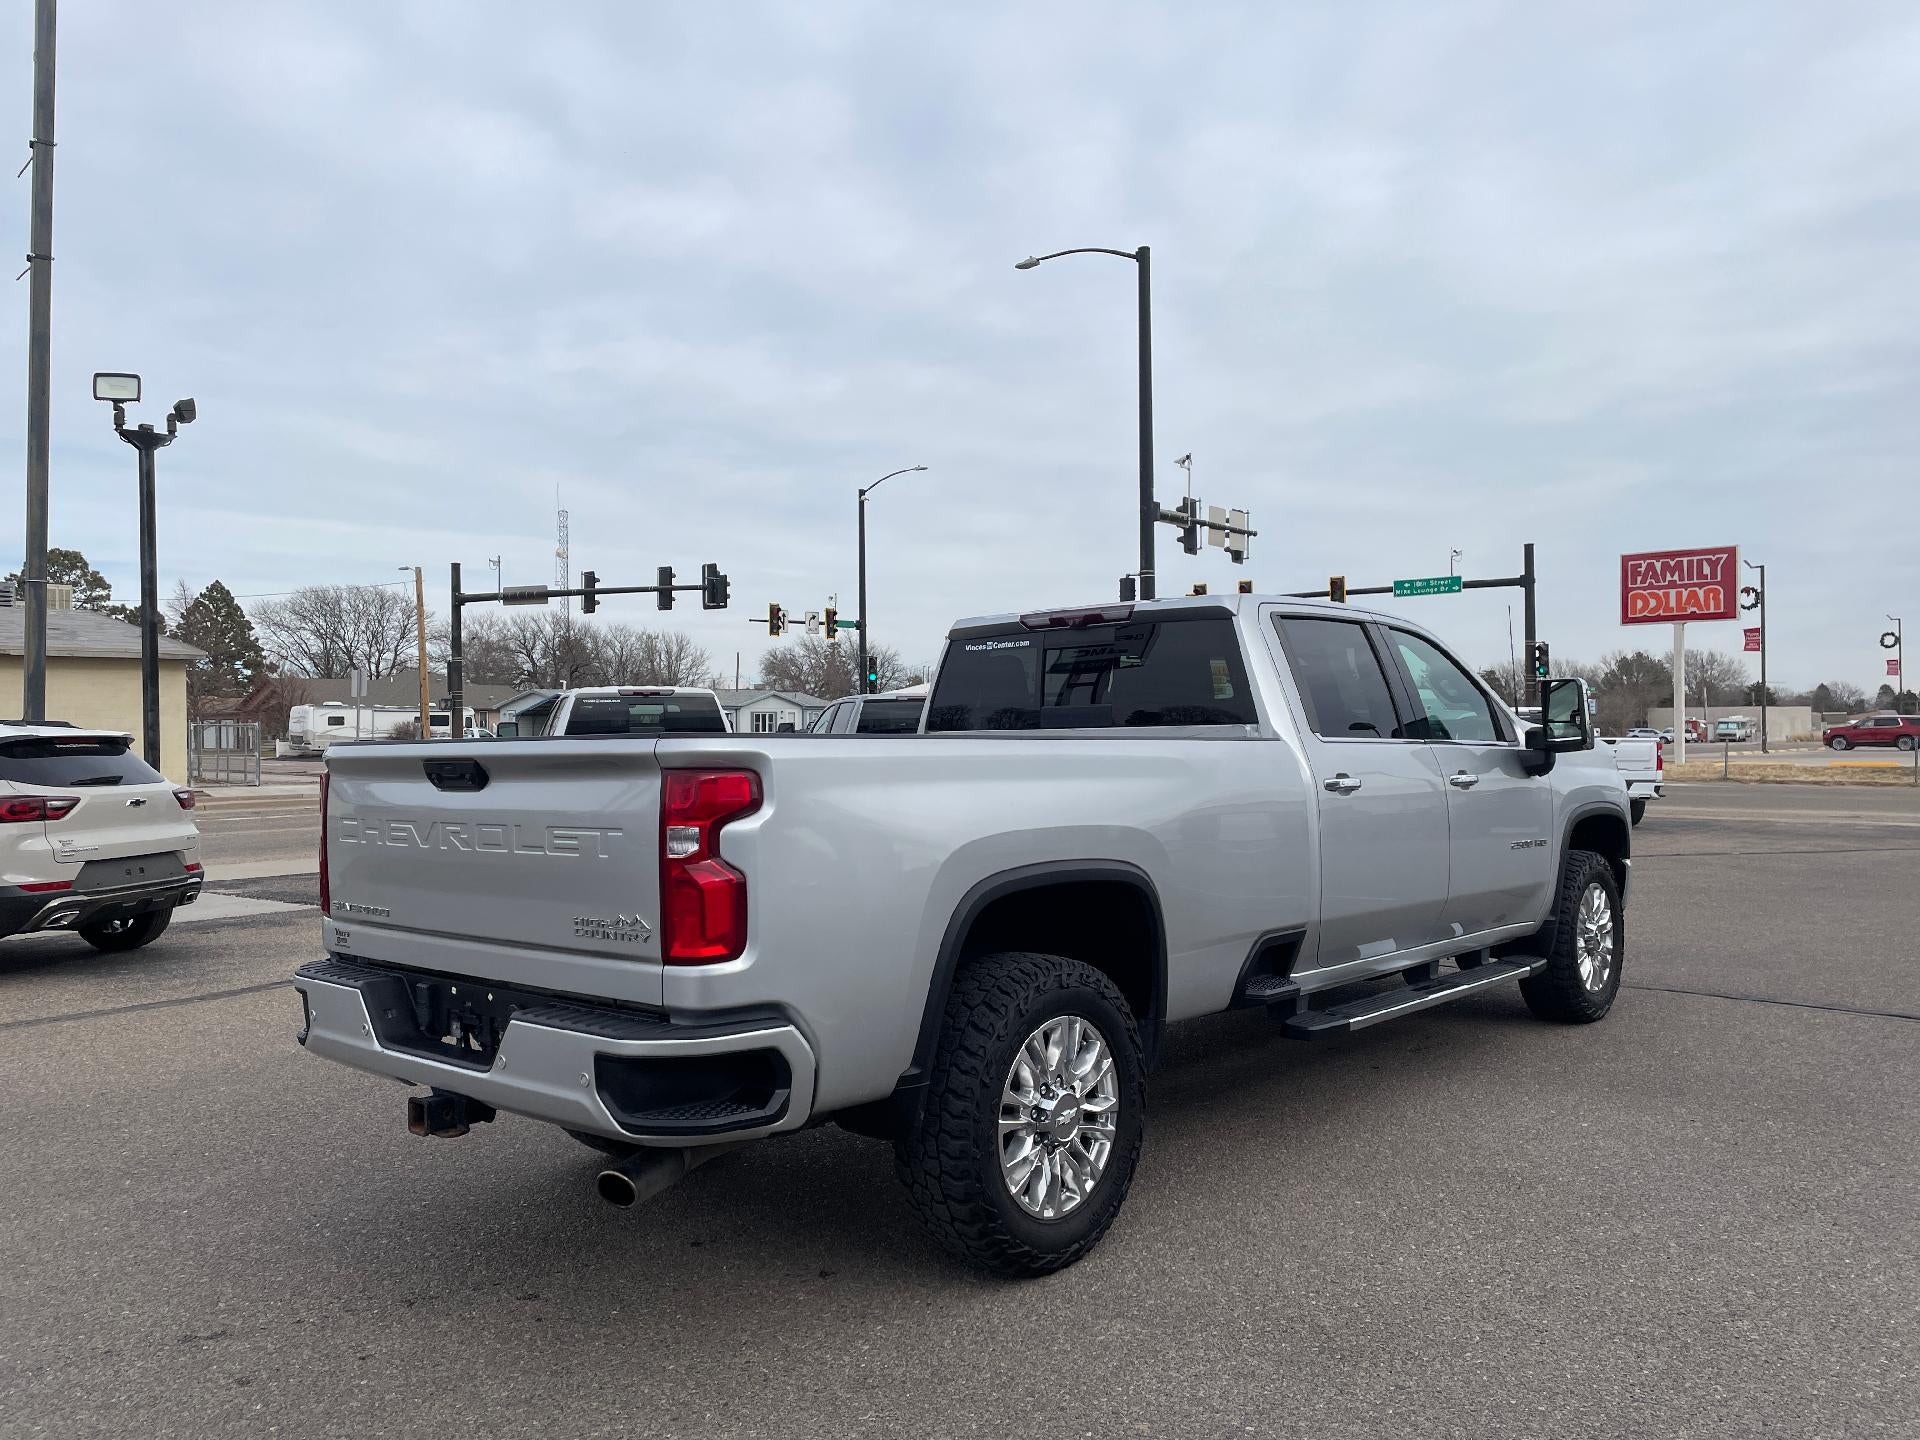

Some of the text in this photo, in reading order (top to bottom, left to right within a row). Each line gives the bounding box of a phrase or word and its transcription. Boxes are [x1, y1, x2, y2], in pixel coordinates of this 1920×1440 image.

[1629, 554, 1728, 587] FAMILY
[1628, 585, 1723, 617] DOLLAR
[339, 817, 623, 858] CHEVROLET
[574, 916, 610, 929] HIGH
[575, 927, 651, 943] COUNTRY
